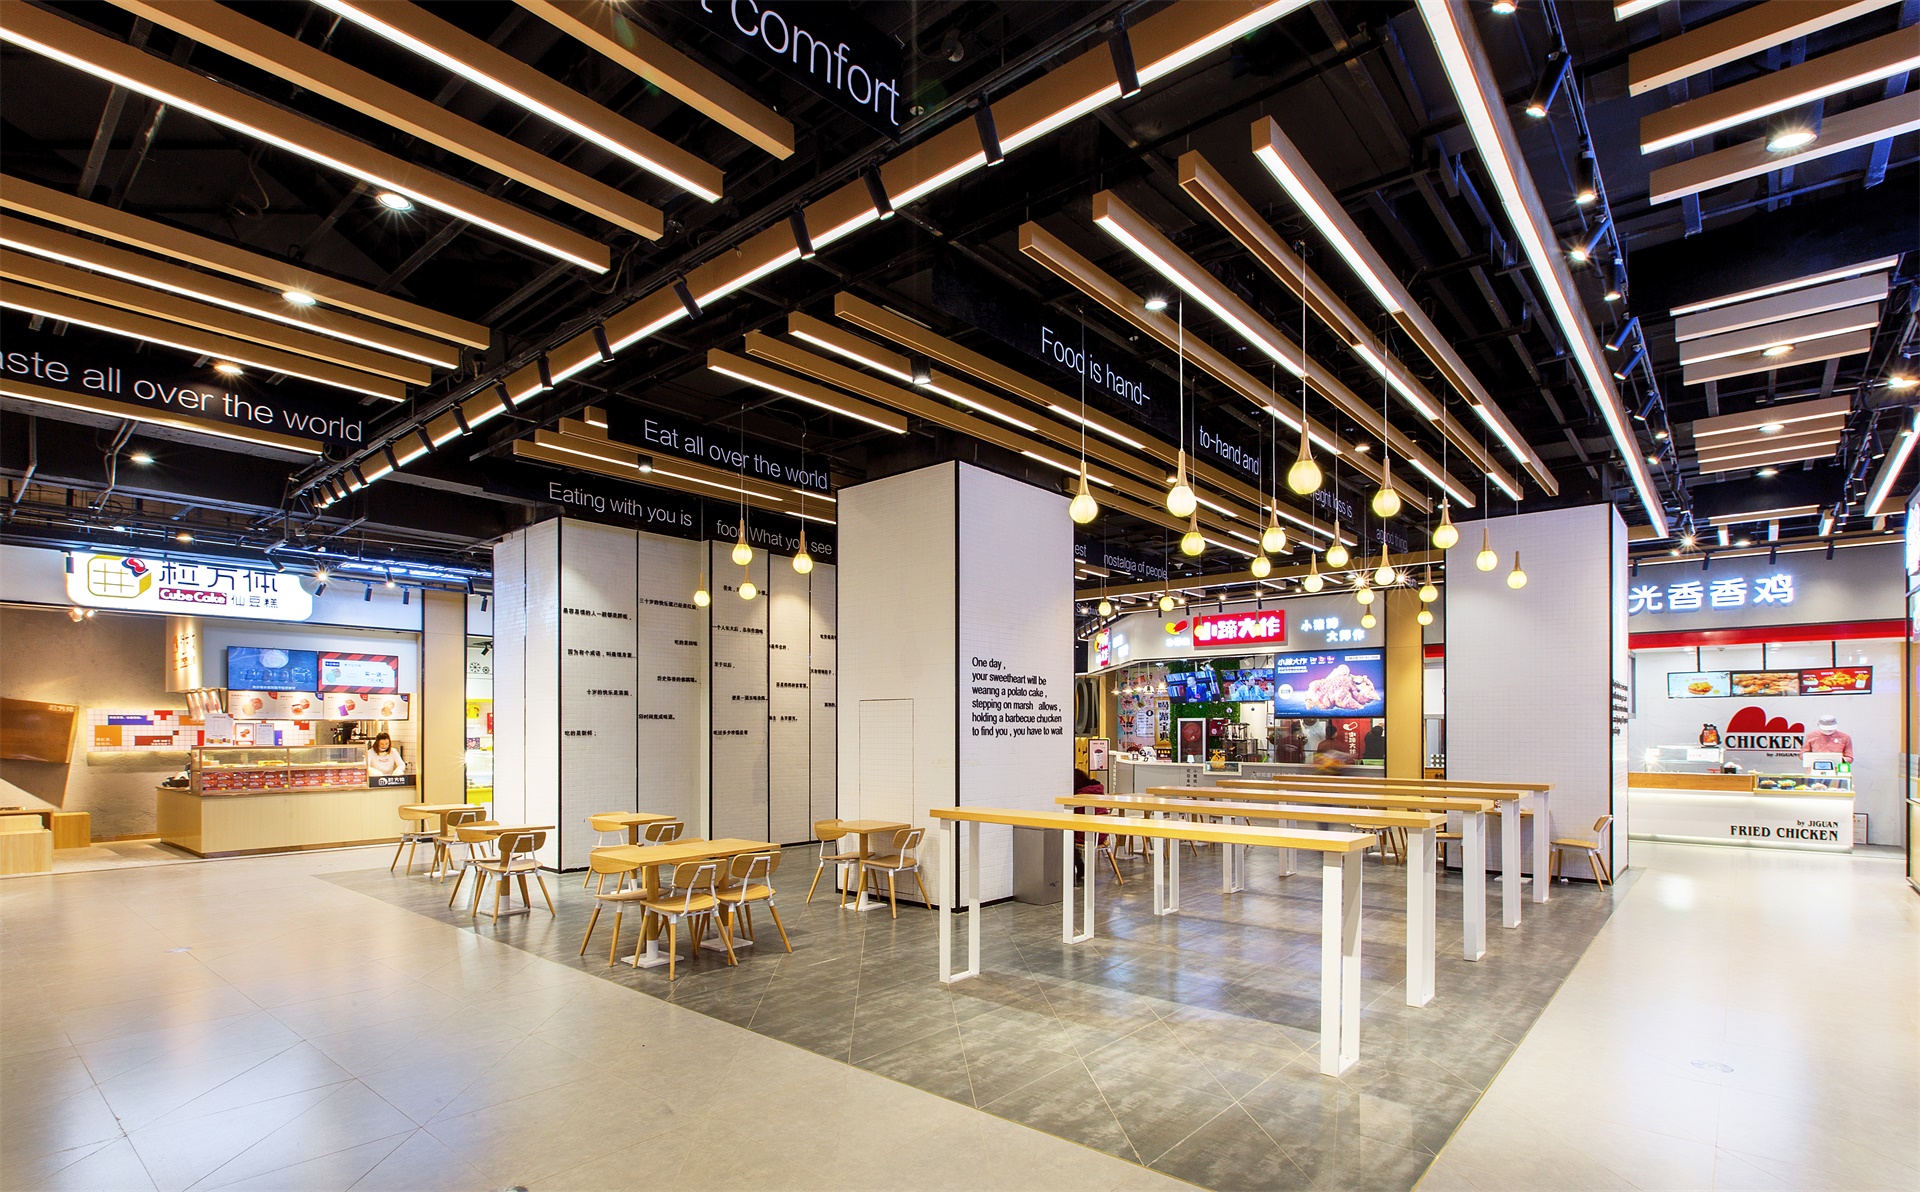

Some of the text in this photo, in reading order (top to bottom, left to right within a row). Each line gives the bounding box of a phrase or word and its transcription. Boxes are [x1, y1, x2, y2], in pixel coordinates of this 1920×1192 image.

[731, 0, 899, 126] comfort
[1042, 325, 1151, 406] Food is hand-
[82, 367, 121, 394] all
[134, 380, 214, 411] over
[222, 393, 274, 424] the
[283, 410, 363, 443] world
[644, 419, 828, 490] Eat all over the world
[1199, 425, 1260, 476] to-hand and
[549, 481, 693, 528] Eating with you is
[1346, 500, 1353, 518] is
[749, 526, 783, 547] What
[811, 541, 832, 555] see
[1104, 554, 1136, 573] nostalgia
[1138, 561, 1145, 573] of
[1146, 565, 1168, 580] people
[1628, 573, 1794, 613] 光香香鸡
[972, 656, 988, 668] One
[972, 672, 1047, 685] your sweetheart will be
[1013, 701, 1034, 710] marsh
[972, 712, 998, 724] holding
[999, 714, 1004, 722] a
[1005, 714, 1036, 723] barbecue
[972, 726, 980, 736] to
[981, 726, 994, 736] find
[1013, 728, 1025, 738] you
[1027, 726, 1042, 736] have
[1044, 726, 1050, 735] to
[1050, 726, 1063, 735] wait
[1725, 735, 1804, 749] CHICKEN
[1730, 825, 1838, 841] FRIED CHICKEN
[1796, 820, 1805, 828] by
